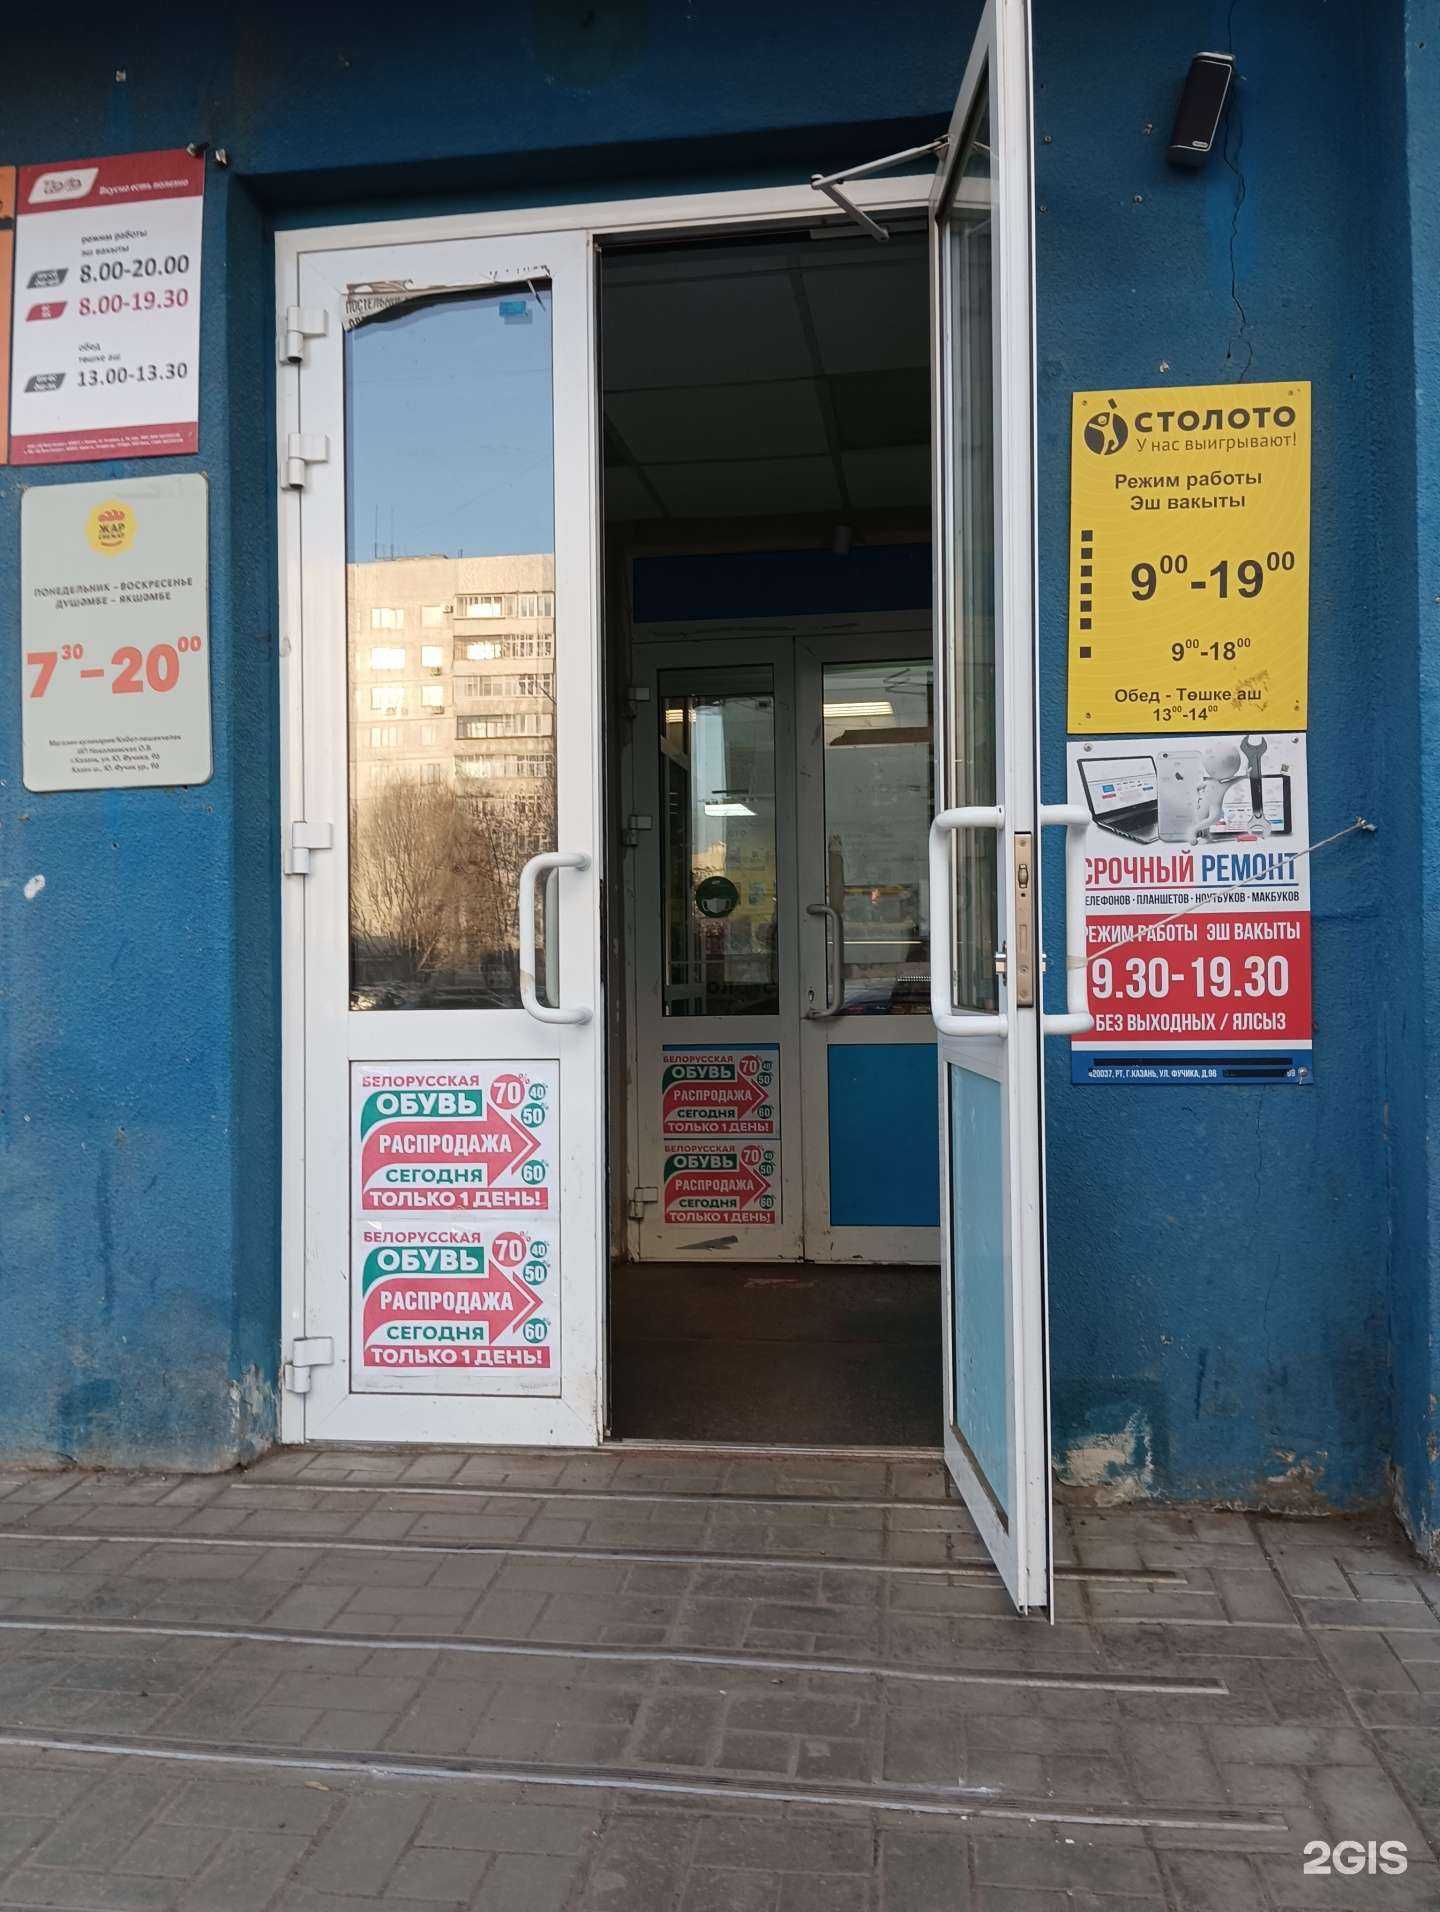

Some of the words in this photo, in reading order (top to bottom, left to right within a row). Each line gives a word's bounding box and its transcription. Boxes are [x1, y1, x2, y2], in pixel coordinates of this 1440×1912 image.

[80, 254, 189, 283] 8.00-20.00
[79, 288, 189, 316] 8.00-19.30
[77, 362, 188, 387] 13.00-13.30
[1134, 406, 1296, 433] СТОЛОТО
[1136, 439, 1147, 452] У
[1151, 439, 1180, 452] нас
[1186, 433, 1297, 453] выигрывают!
[1115, 473, 1180, 489] Режим
[1186, 471, 1262, 490] работы
[1131, 496, 1161, 511] Эш
[1168, 494, 1246, 509] вакыты
[34, 582, 110, 598] ПОНЕДЕЛЬНИК
[120, 577, 193, 591] ВОСКРЕСЕНЬЕ
[1115, 689, 1160, 704] Обед
[1177, 688, 1232, 702] Төшке
[1237, 690, 1262, 701] аш
[1202, 853, 1299, 882] РЕМОНТ
[1085, 895, 1131, 906] ЕЛЕФОНОВ
[1136, 894, 1189, 905] ПЛАНШЕТОВ
[1195, 892, 1246, 903] НОУТБУКОВ
[1251, 891, 1300, 902] МАКБУКОВ
[1086, 924, 1134, 943] ЕЖИМ
[1138, 924, 1198, 942] РАБОТЫ
[1206, 923, 1230, 941] ЭШ
[1234, 922, 1300, 940] ВАКЫТЫ
[1096, 1014, 1123, 1031] БЕЗ
[1127, 1013, 1216, 1032] ВЫХОДНЫХ
[1232, 1012, 1287, 1031] ЯЛСЫЗ
[663, 1055, 734, 1064] БЕЛОРУССКАЯ
[362, 1075, 480, 1088] БЕЛОРУССКАЯ
[671, 1066, 732, 1080] ОБУВЬ
[376, 1093, 478, 1116] ОБУВЬ
[673, 1089, 753, 1103] РАСПРОДАЖА
[522, 1108, 543, 1125] 50
[677, 1108, 736, 1119] СЕГОДНЯ
[667, 1122, 719, 1132] ТОЛЬКО
[721, 1122, 727, 1131] 1
[728, 1121, 770, 1133] ДЕНЬ!
[379, 1134, 512, 1156] РАСПРОДАЖА
[664, 1145, 736, 1153] БЕЛОРУССКАЯ
[673, 1155, 733, 1169] ОБУВЬ
[386, 1168, 483, 1184] СЕГОДНЯ
[523, 1165, 543, 1181] 60
[675, 1179, 754, 1192] РАСПРОДАЖА
[370, 1191, 457, 1207] ТОЛЬКО
[460, 1192, 469, 1206] 1
[473, 1191, 541, 1209] ДЕНЬ!
[678, 1199, 737, 1210] СЕГОДНЯ
[669, 1212, 721, 1223] ТОЛЬКО
[723, 1212, 729, 1222] 1
[730, 1212, 771, 1224] ДЕНЬ!
[363, 1231, 481, 1244] БЕЛОРУССКАЯ
[377, 1249, 479, 1272] ОБУВЬ
[524, 1265, 545, 1282] 50
[380, 1290, 514, 1314] РАСПРОДАЖА
[386, 1325, 485, 1342] СЕГОДНЯ
[524, 1323, 545, 1341] 60
[371, 1348, 459, 1365] ТОЛЬКО
[462, 1349, 471, 1364] 1
[474, 1348, 543, 1366] ДЕНЬ!
